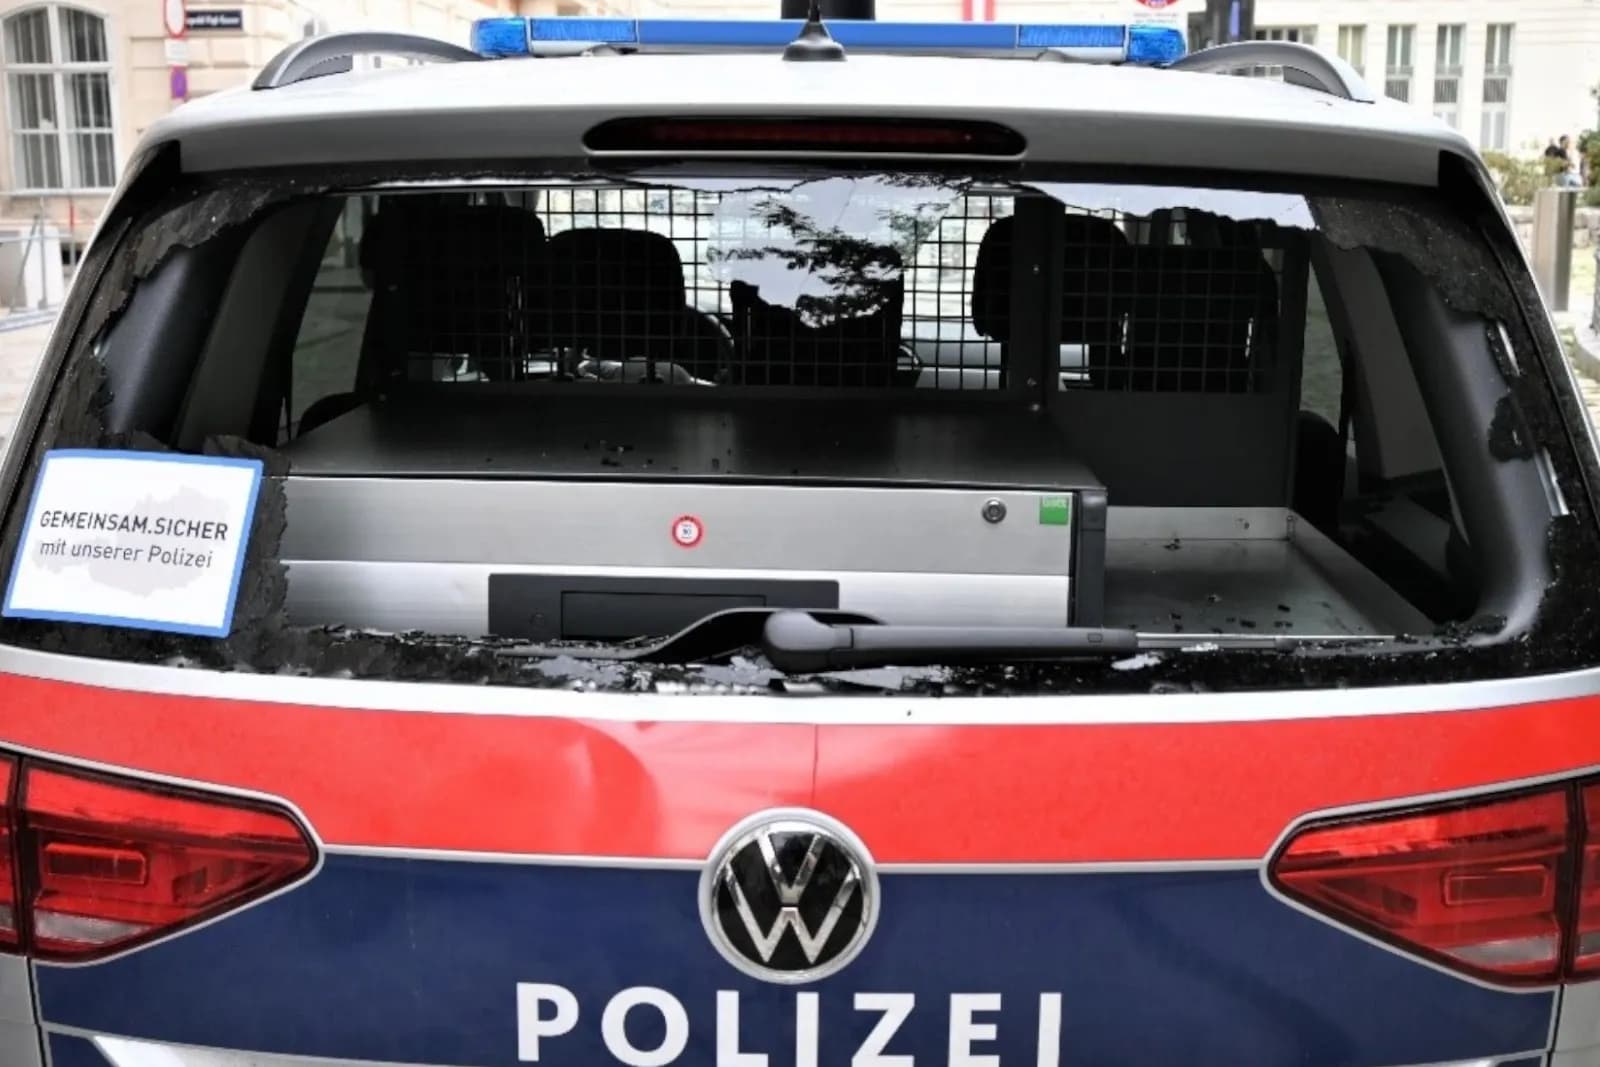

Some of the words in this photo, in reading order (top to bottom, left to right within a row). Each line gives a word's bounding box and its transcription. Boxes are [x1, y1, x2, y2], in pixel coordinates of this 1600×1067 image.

[40, 511, 228, 540] GEMEINSAM.SICHER
[39, 538, 67, 556] mit
[71, 542, 143, 561] unserer
[148, 545, 213, 568] Polizei
[515, 981, 1063, 1067] POLIZEI
